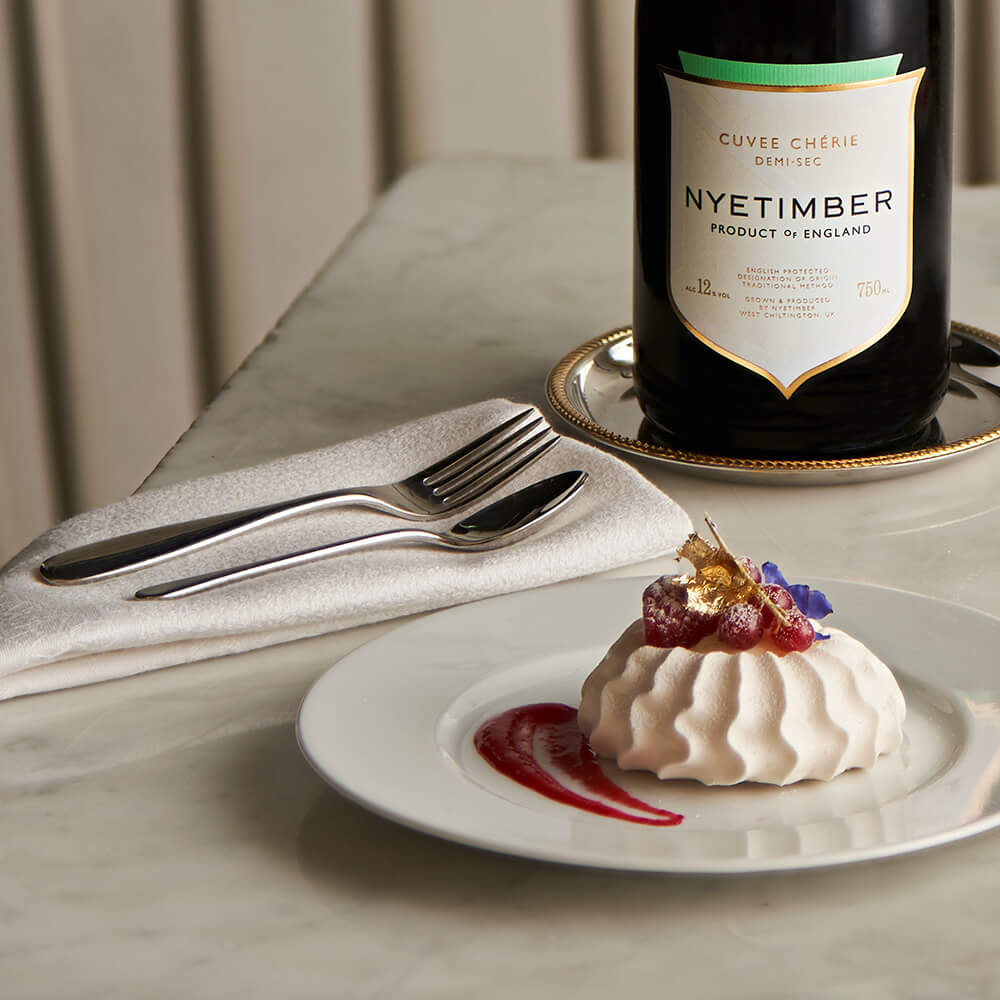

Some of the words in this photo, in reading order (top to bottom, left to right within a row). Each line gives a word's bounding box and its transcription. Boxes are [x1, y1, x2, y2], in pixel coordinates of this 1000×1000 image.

[719, 133, 780, 150] CUVEE
[790, 134, 859, 150] CHÉRIE
[754, 156, 823, 168] DEMI-SEC
[685, 185, 893, 220] NYETIMBER
[711, 223, 777, 239] PRODUCT
[804, 224, 872, 239] ENGLAND
[783, 267, 829, 275] PROTECTED
[737, 273, 792, 282] DESIGNATION
[742, 281, 797, 290] TRADITIONAL
[744, 296, 776, 304] GROWN
[787, 297, 831, 305] PRODUCED
[739, 310, 761, 318] WEST
